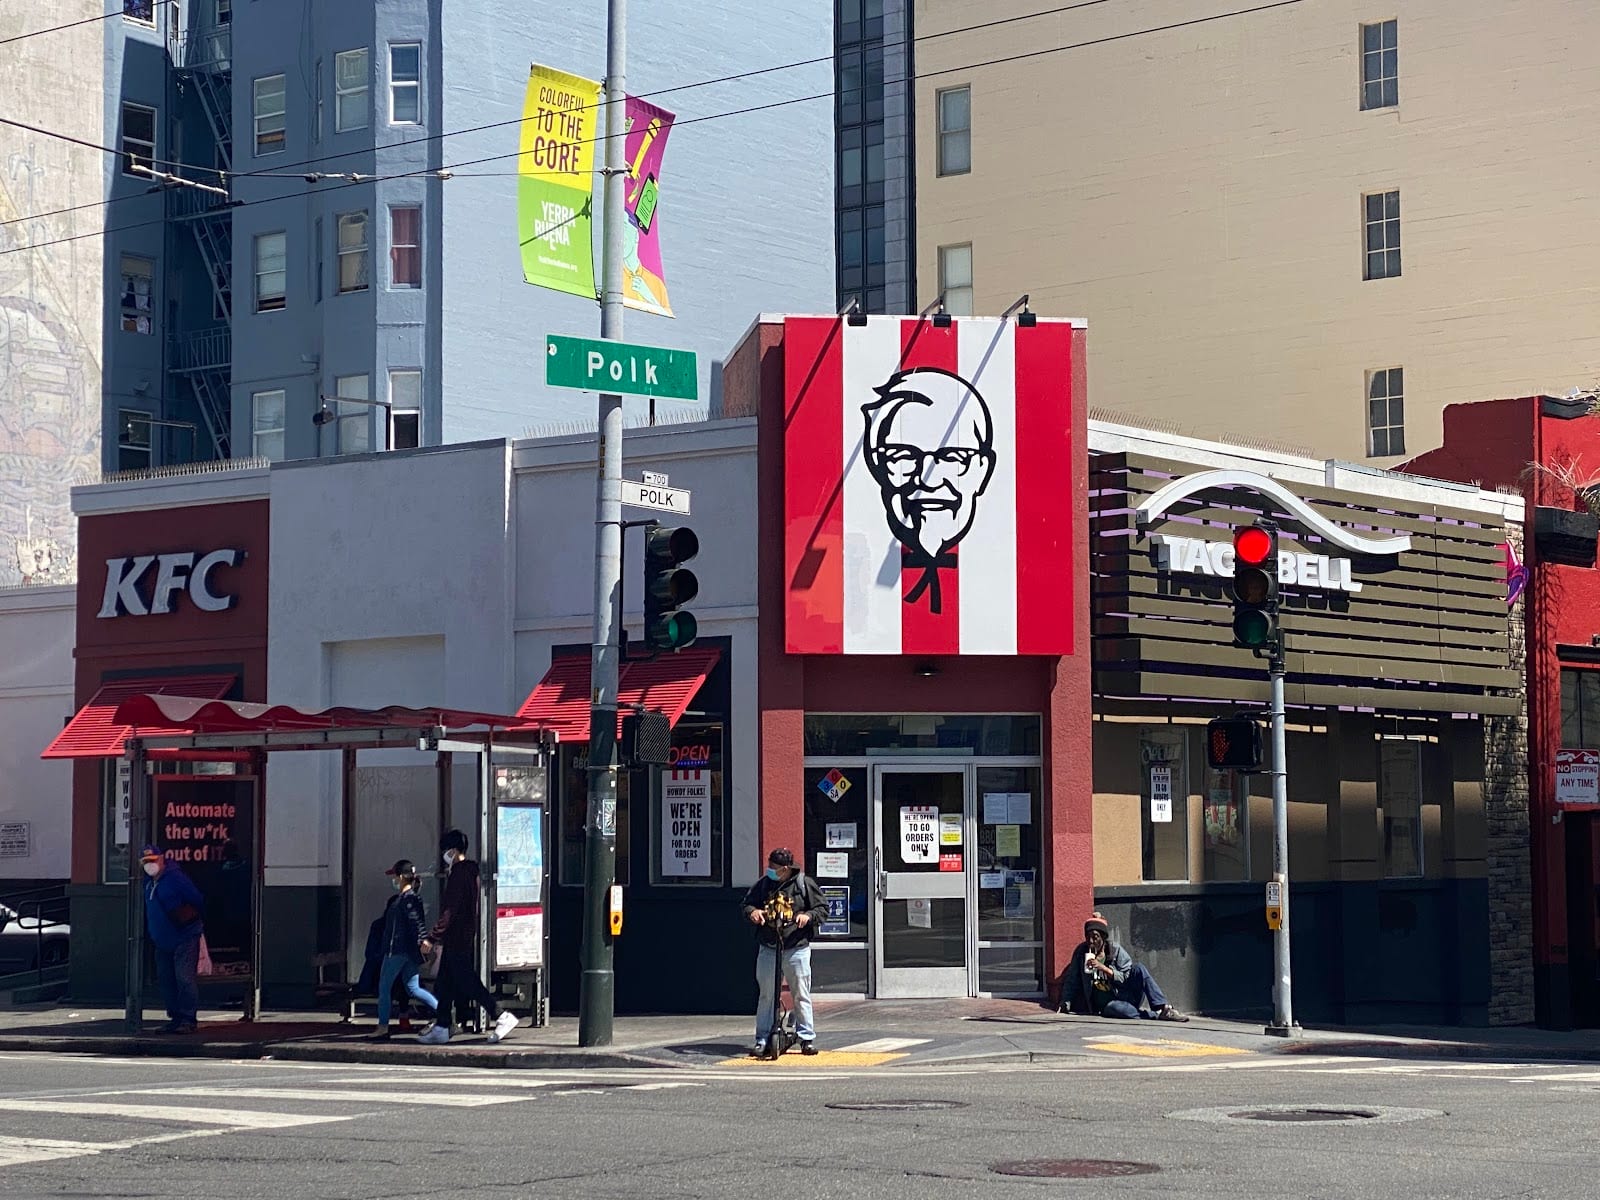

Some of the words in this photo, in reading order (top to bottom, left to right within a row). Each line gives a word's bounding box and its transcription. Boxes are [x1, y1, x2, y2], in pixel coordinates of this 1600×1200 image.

[539, 86, 585, 113] COLORFUL
[537, 106, 554, 133] TO
[559, 111, 584, 141] THE
[534, 135, 581, 175] CORE
[587, 351, 659, 385] Polk
[653, 474, 666, 485] 700
[640, 488, 674, 507] POLK
[1161, 535, 1236, 578] TAC
[1277, 550, 1363, 592] BELL
[96, 548, 237, 618] KFC
[667, 744, 710, 765] OPEN
[666, 787, 686, 796] HOWDY
[1561, 778, 1574, 787] ANY
[1577, 779, 1594, 788] TIME
[830, 789, 839, 799] SA
[165, 802, 236, 818] Automate
[670, 802, 703, 819] WE'RE
[165, 823, 191, 840] the
[672, 820, 701, 837] OPEN
[909, 823, 918, 831] TO
[920, 823, 930, 831] GO
[671, 839, 683, 849] FOR
[684, 839, 692, 849] TO
[692, 839, 701, 849] GO
[905, 833, 934, 842] ORDERS
[165, 846, 191, 862] out
[193, 845, 209, 862] of
[674, 849, 698, 859] ORDERS
[911, 843, 929, 852] ONLY
